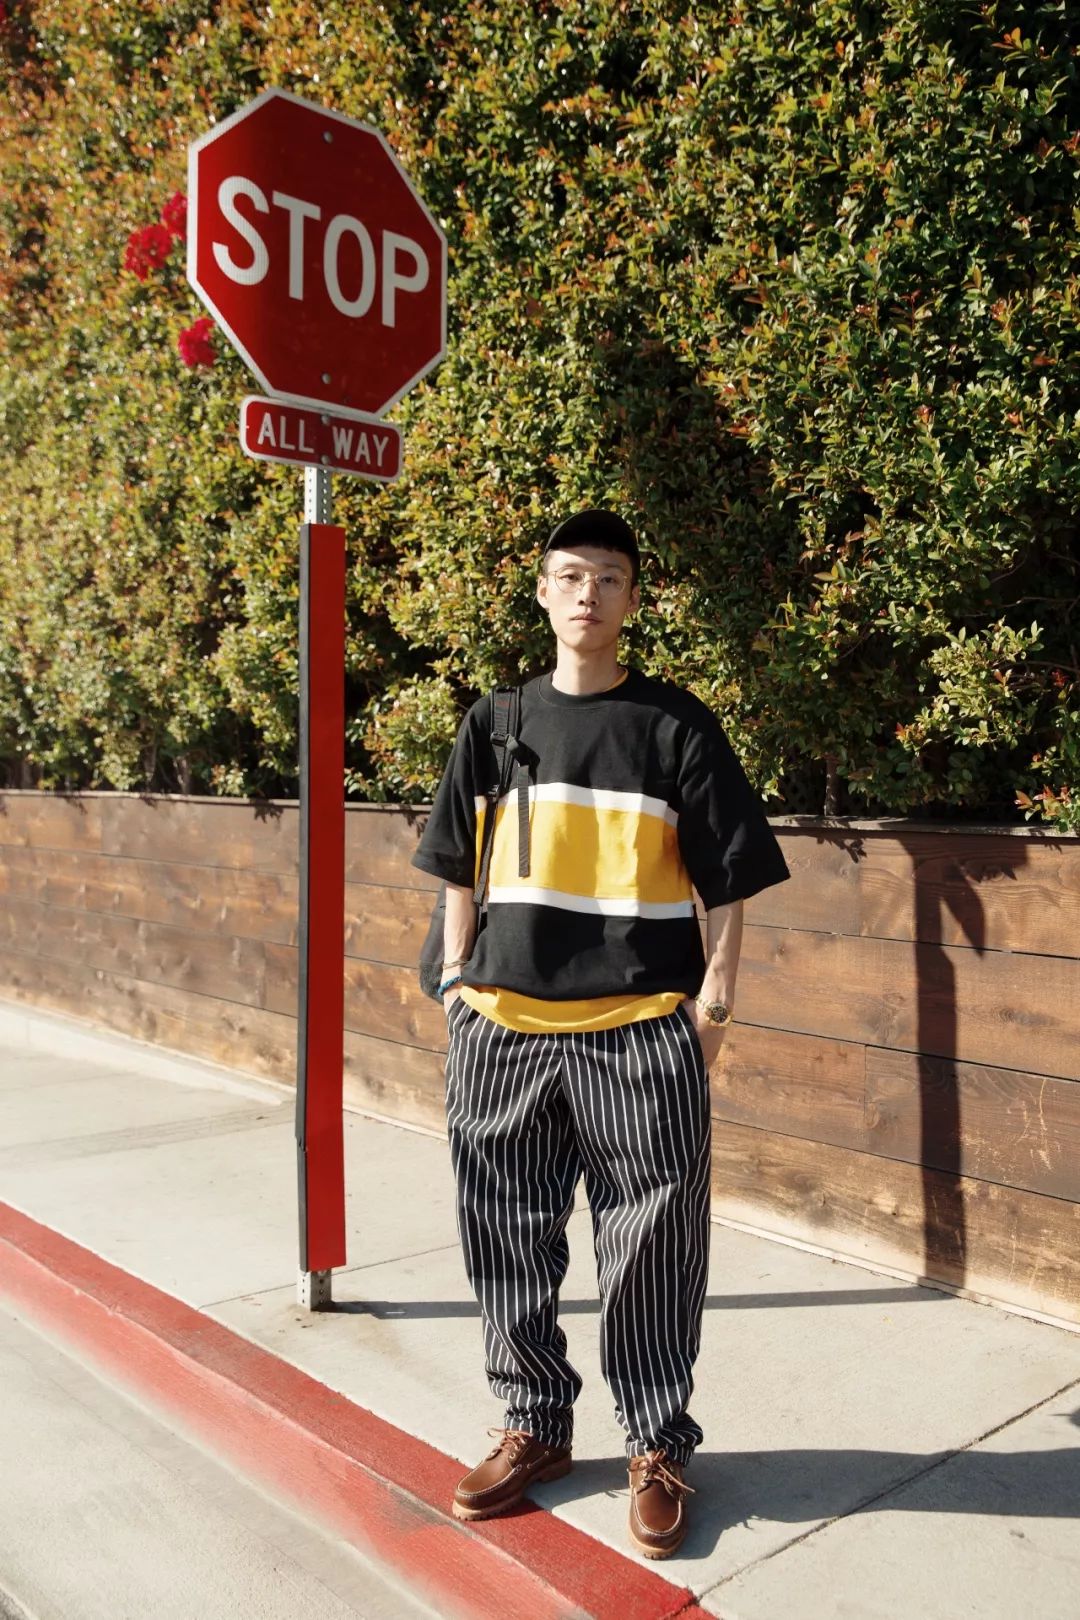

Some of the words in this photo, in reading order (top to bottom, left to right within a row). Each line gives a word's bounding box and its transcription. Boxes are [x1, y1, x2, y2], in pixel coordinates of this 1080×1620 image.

[212, 175, 430, 328] STOP
[257, 412, 315, 454] ALL
[332, 425, 389, 467] WAY
